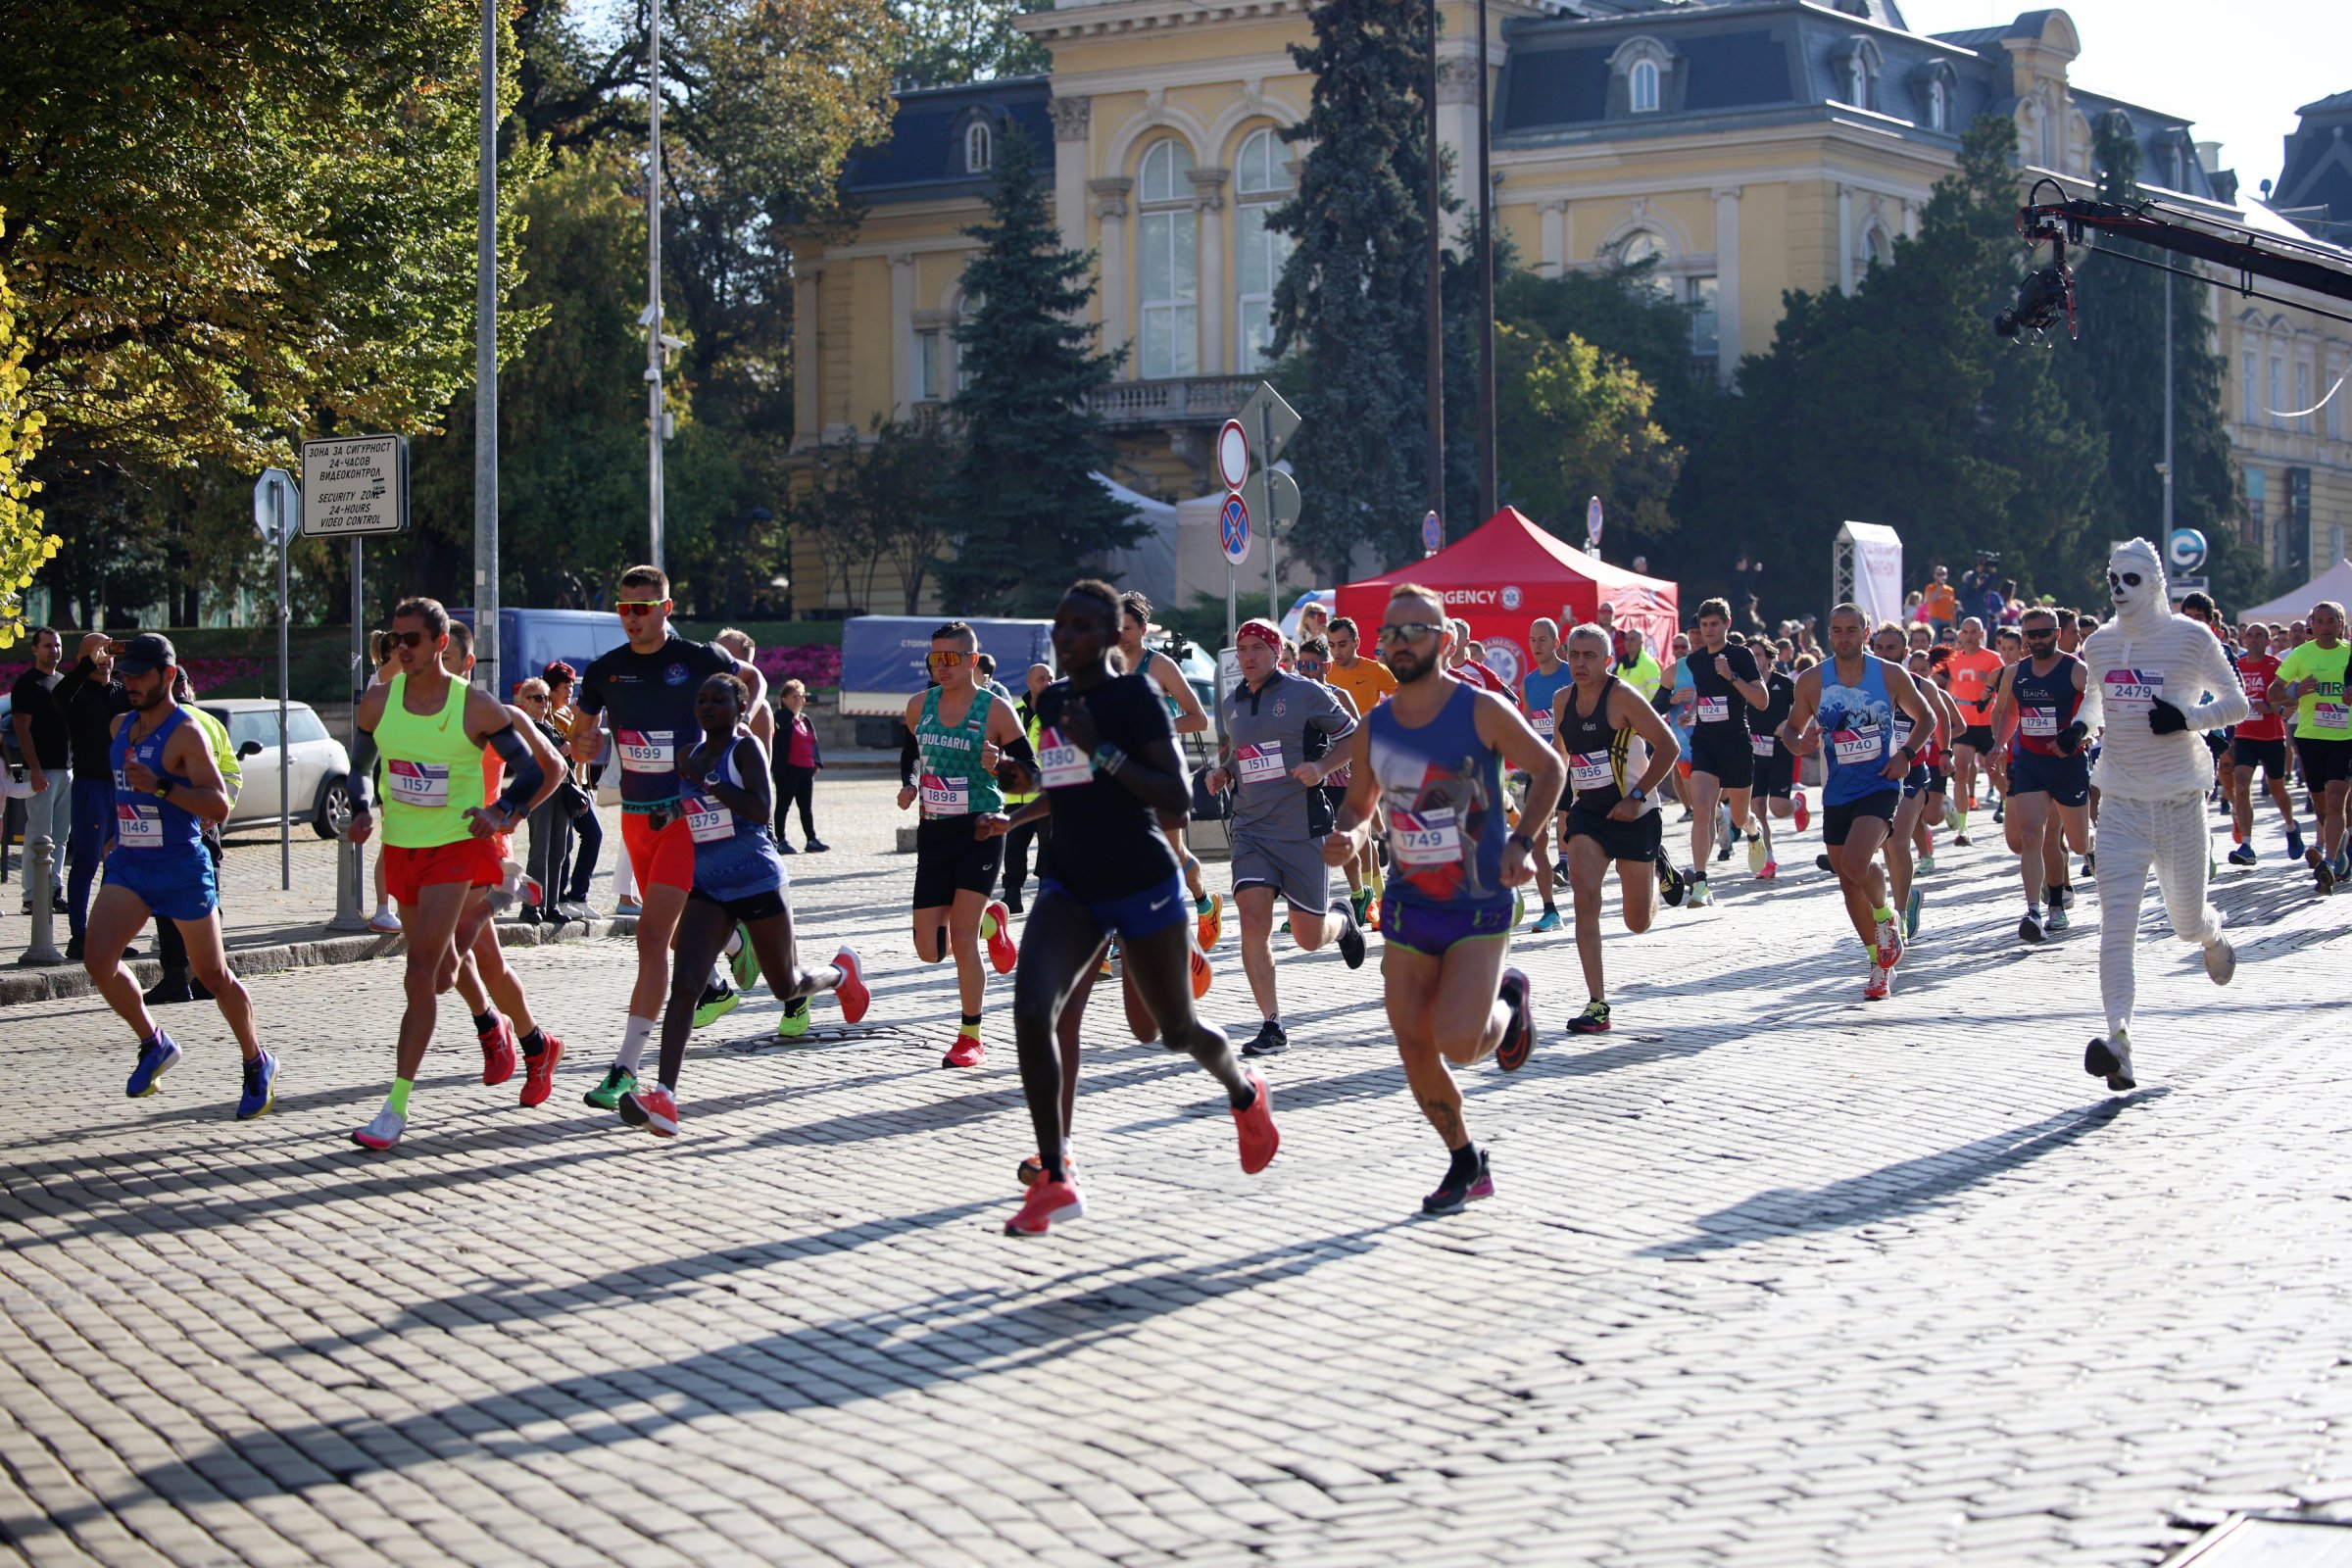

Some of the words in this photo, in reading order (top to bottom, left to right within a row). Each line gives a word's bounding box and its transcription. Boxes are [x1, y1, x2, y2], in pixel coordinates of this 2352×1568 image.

[309, 447, 329, 458] ЗОНА
[333, 446, 343, 456] ЗА
[346, 442, 392, 455] СИГУРНОСТ
[329, 456, 370, 468] 24-ЧАСОВ
[319, 467, 381, 481] ВИДЕОКОНТРОЛ
[318, 492, 356, 503] SECURITY
[329, 504, 370, 515] 24-HOURS
[320, 516, 343, 527] VIDEO
[346, 514, 381, 525] CONTROL
[1437, 590, 1497, 605] RGENCY
[2115, 685, 2152, 698] 2479
[2321, 711, 2342, 720] 1245
[2027, 718, 2048, 727] 1794
[922, 733, 971, 752] BULGARIA
[1842, 740, 1872, 753] 1740
[628, 746, 662, 760] 1699
[1248, 757, 1270, 770] 1511
[1576, 766, 1601, 778] 1956
[402, 777, 433, 792] 1157
[929, 790, 957, 803] 1898
[690, 812, 719, 828] 2379
[122, 821, 149, 833] 1146
[1401, 831, 1442, 847] 1749
